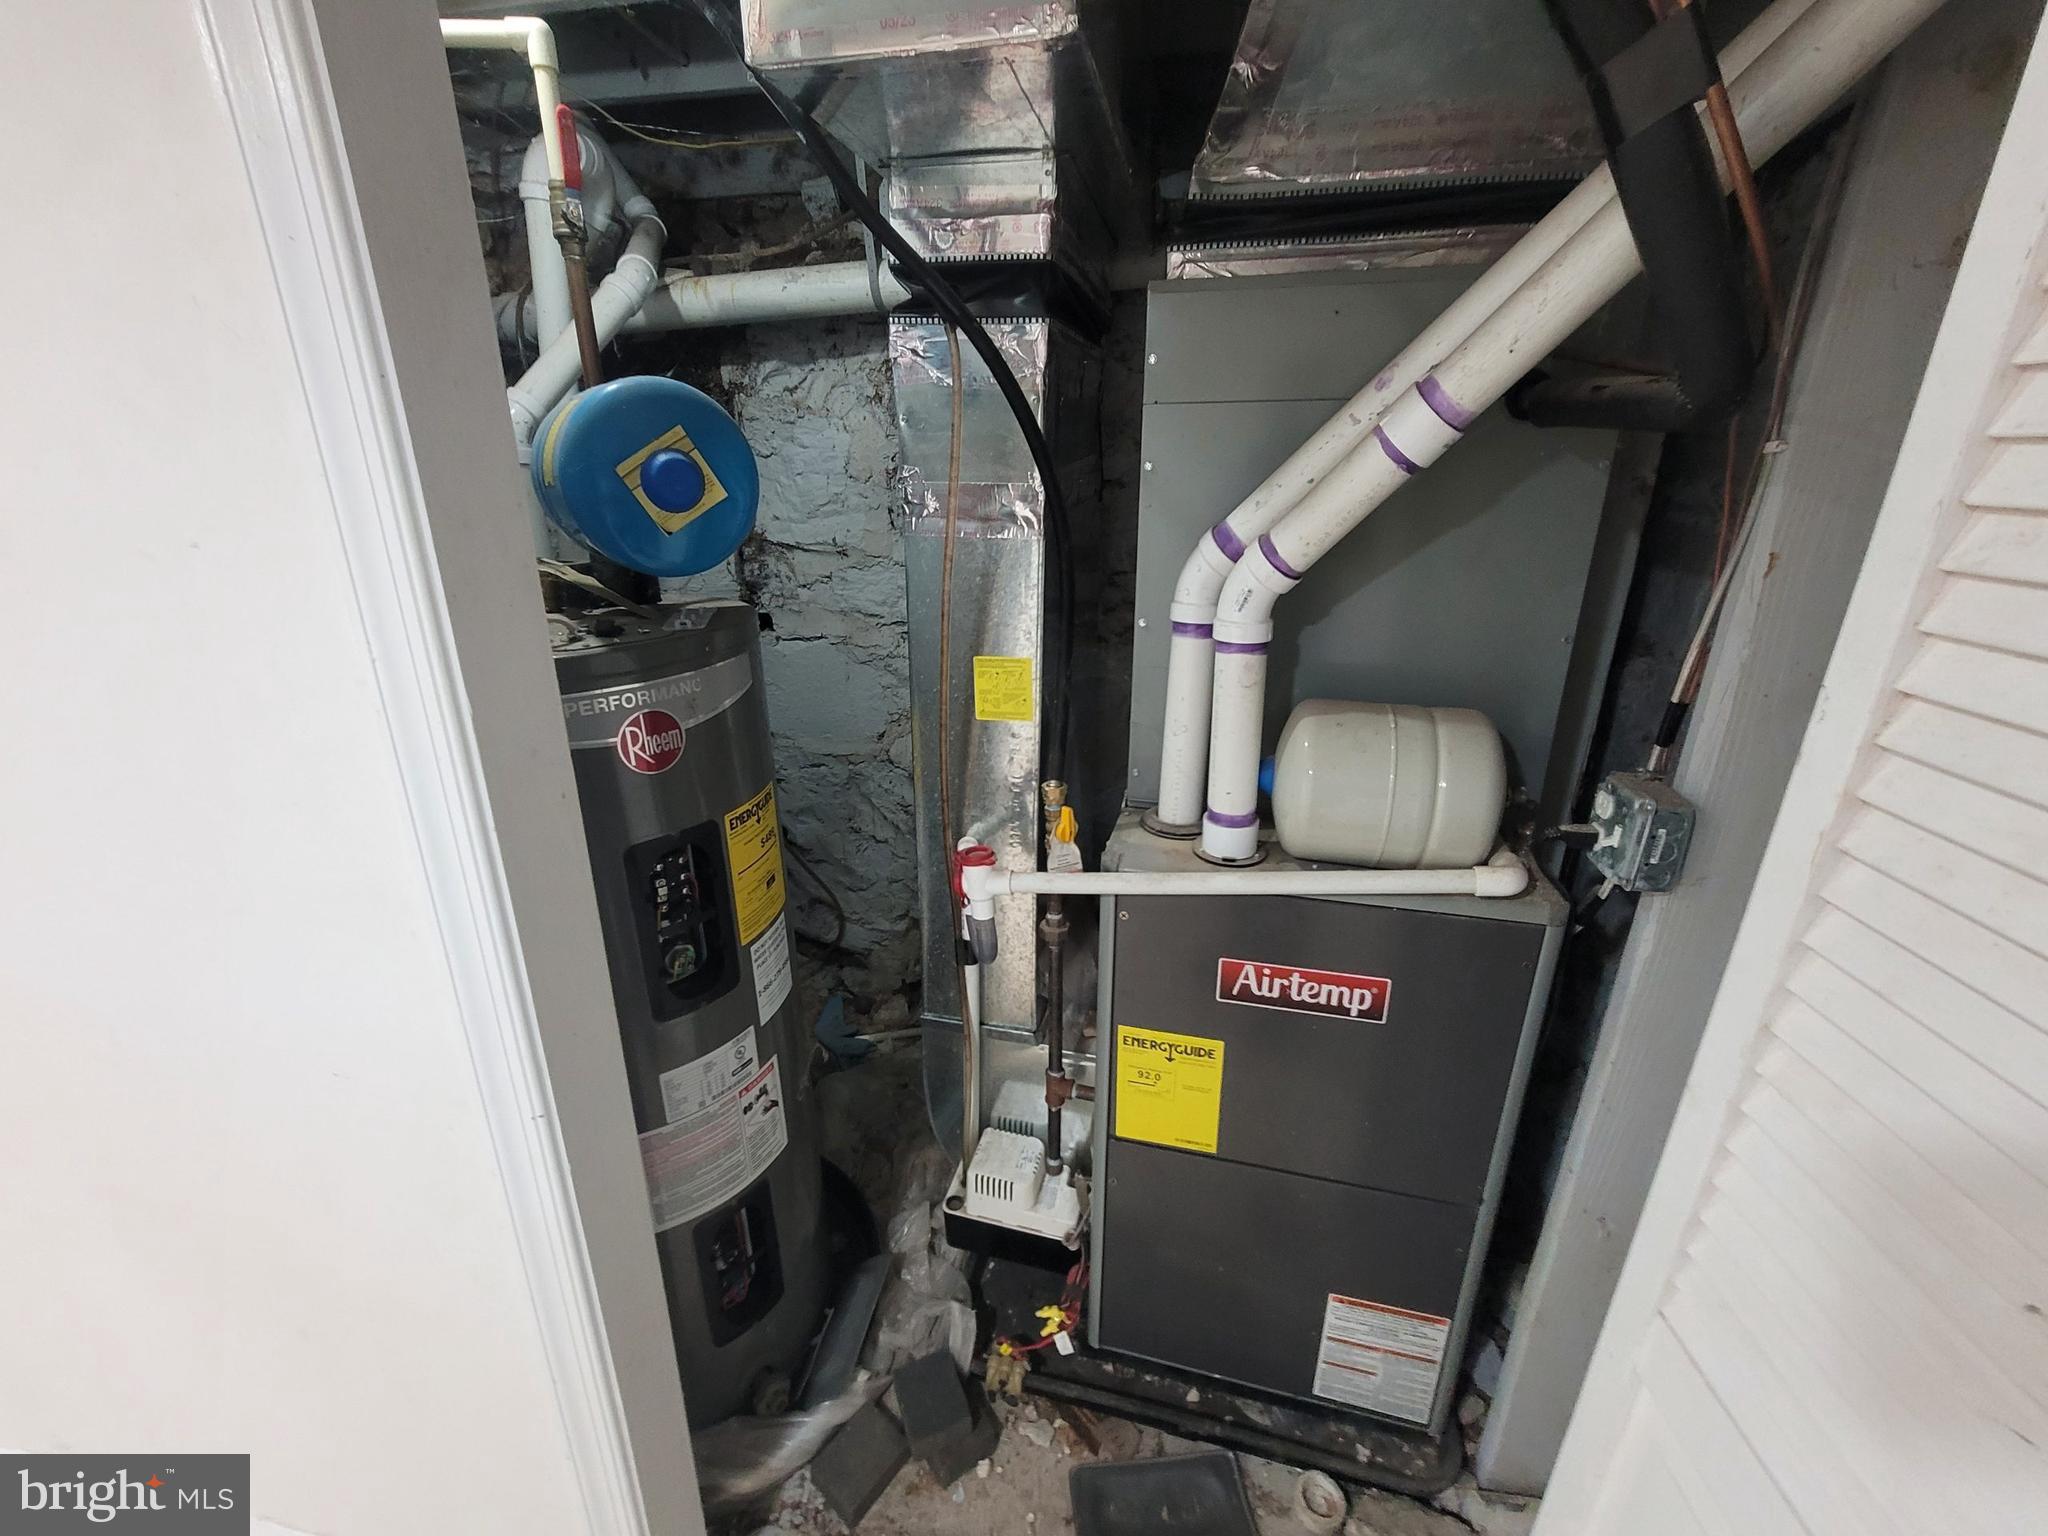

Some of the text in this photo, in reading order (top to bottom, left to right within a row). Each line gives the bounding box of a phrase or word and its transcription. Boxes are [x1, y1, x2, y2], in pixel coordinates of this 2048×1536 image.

[625, 712, 682, 767] Rheem
[1231, 964, 1372, 1017] Airtemp
[1122, 1035, 1217, 1062] ENERGYGUIDE
[1137, 1070, 1162, 1082] 92.0
